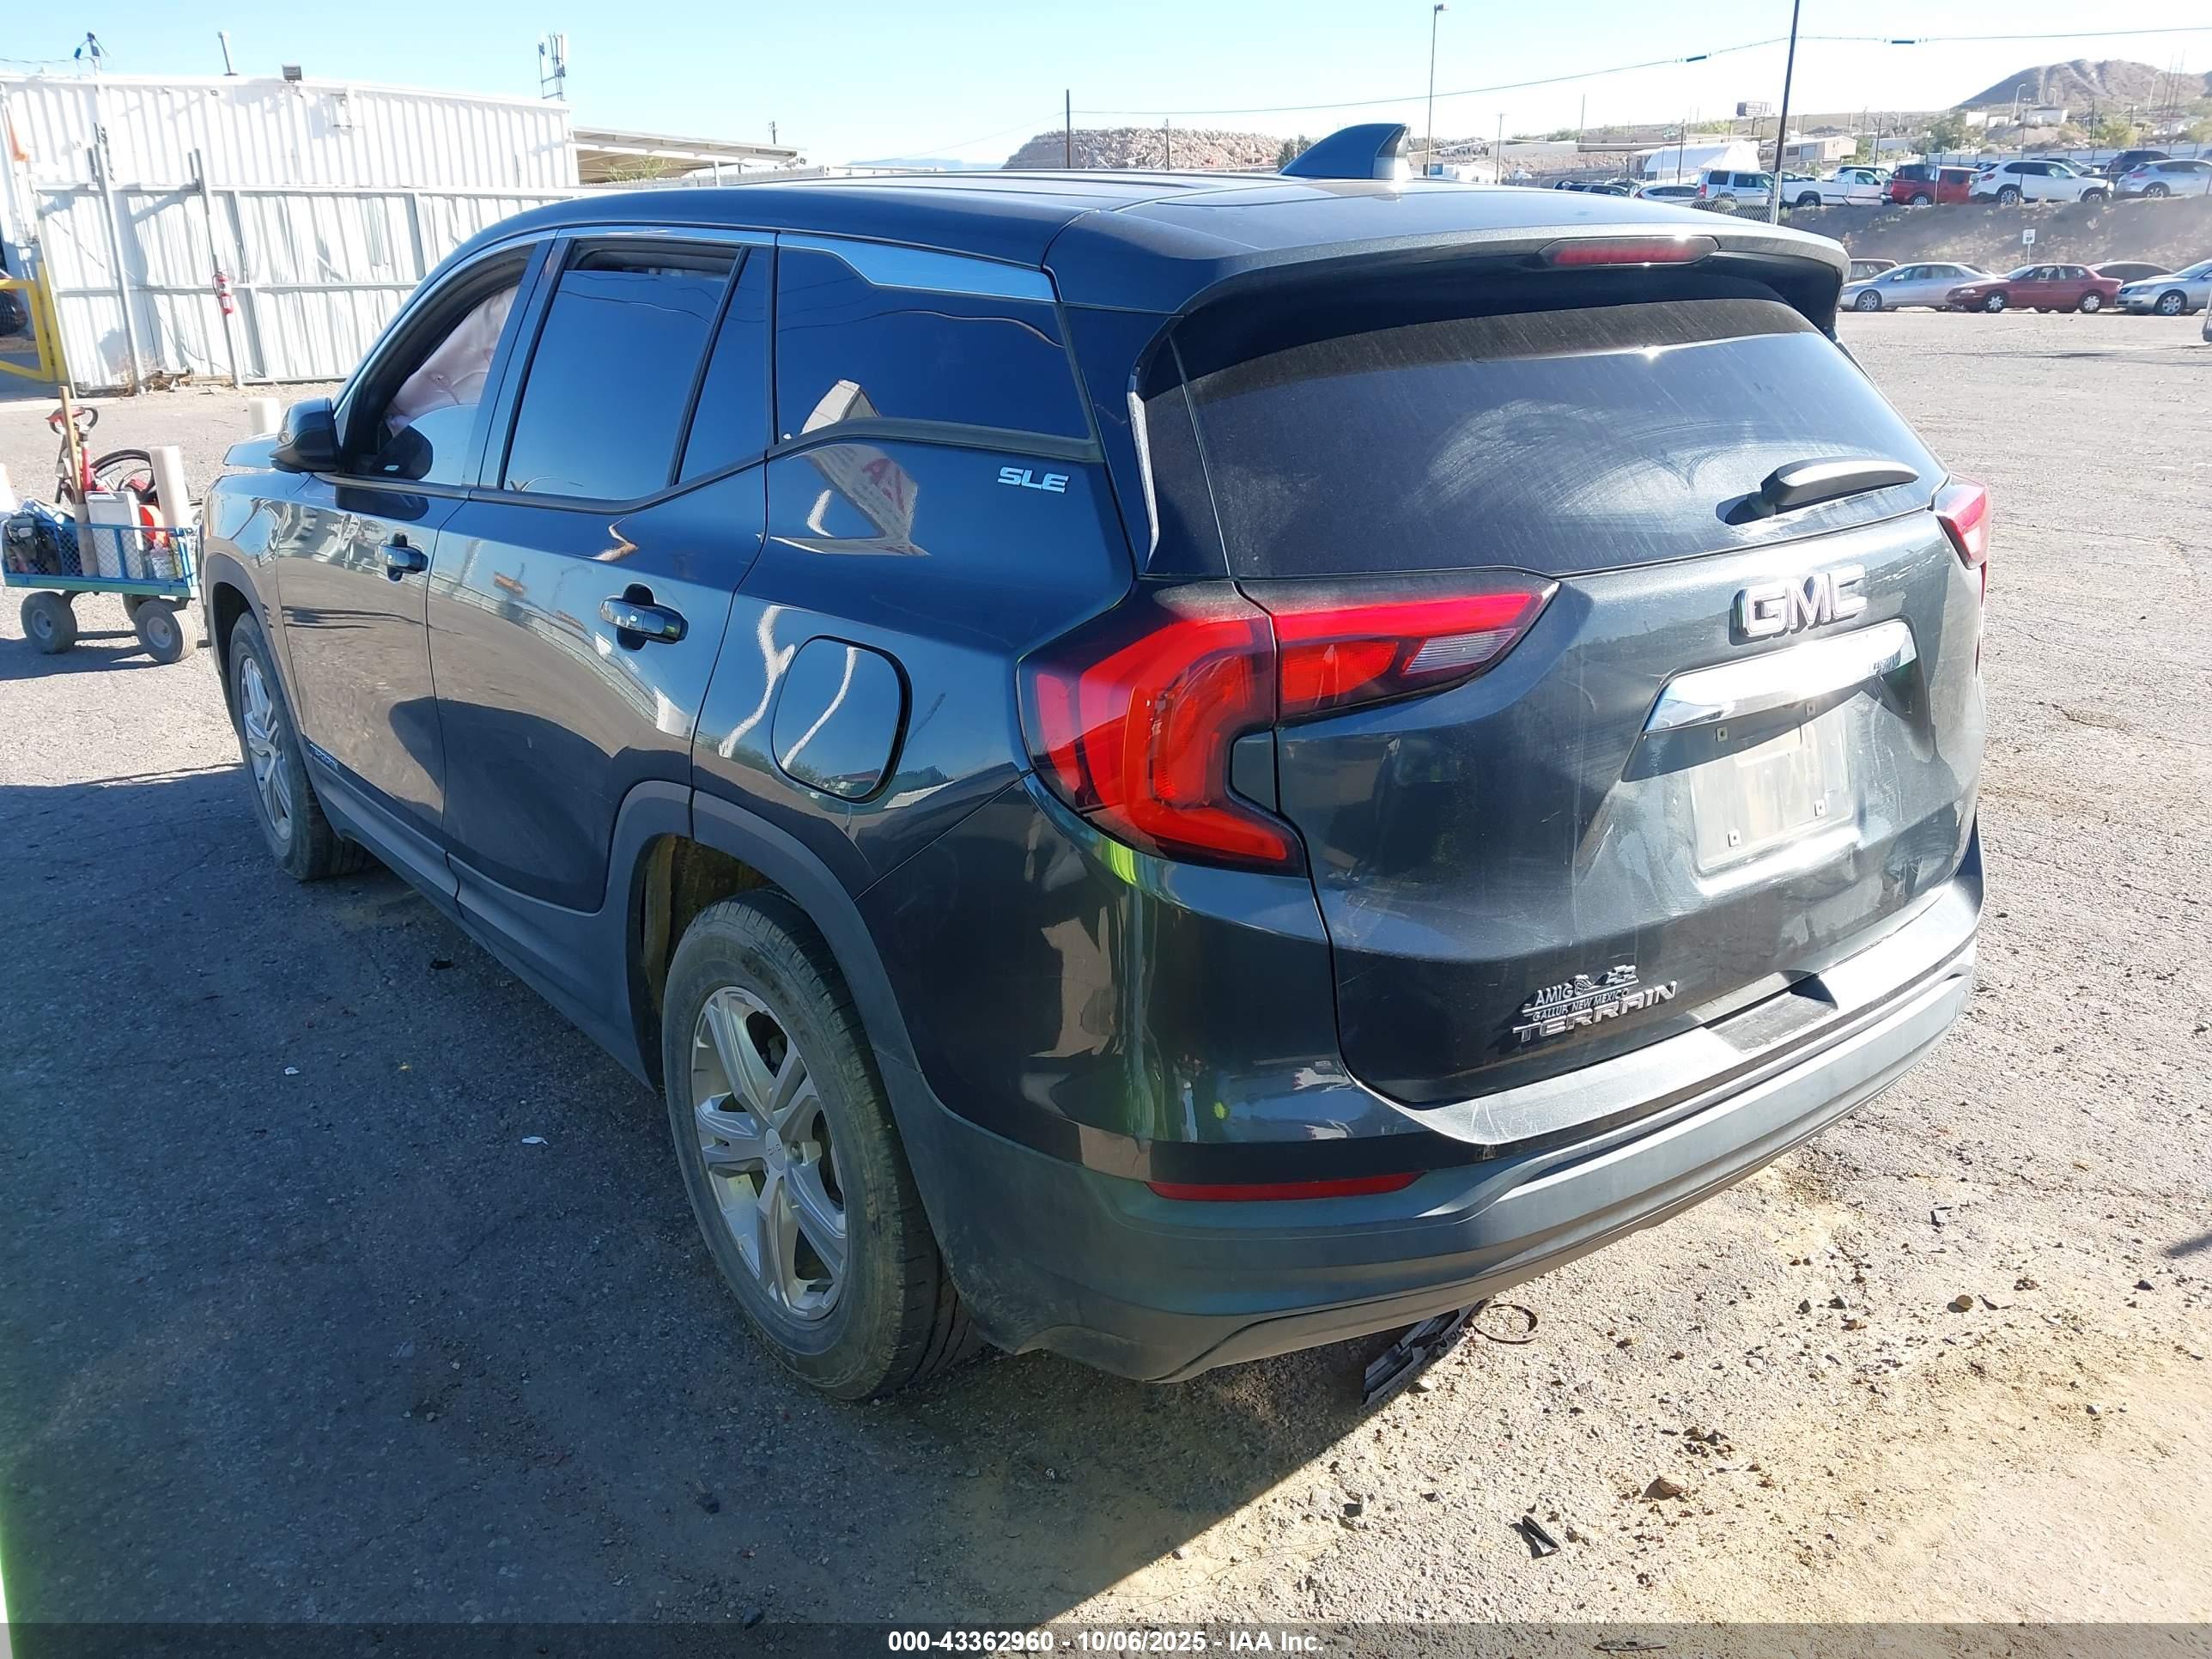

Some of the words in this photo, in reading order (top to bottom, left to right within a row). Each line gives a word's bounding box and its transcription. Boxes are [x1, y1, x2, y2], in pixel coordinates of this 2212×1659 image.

[997, 466, 1070, 494] SLE
[1741, 563, 1868, 637] GMC
[1512, 981, 1679, 1042] TERRAIN
[1571, 998, 1592, 1012] NEW
[1593, 988, 1629, 1007] MEXICO
